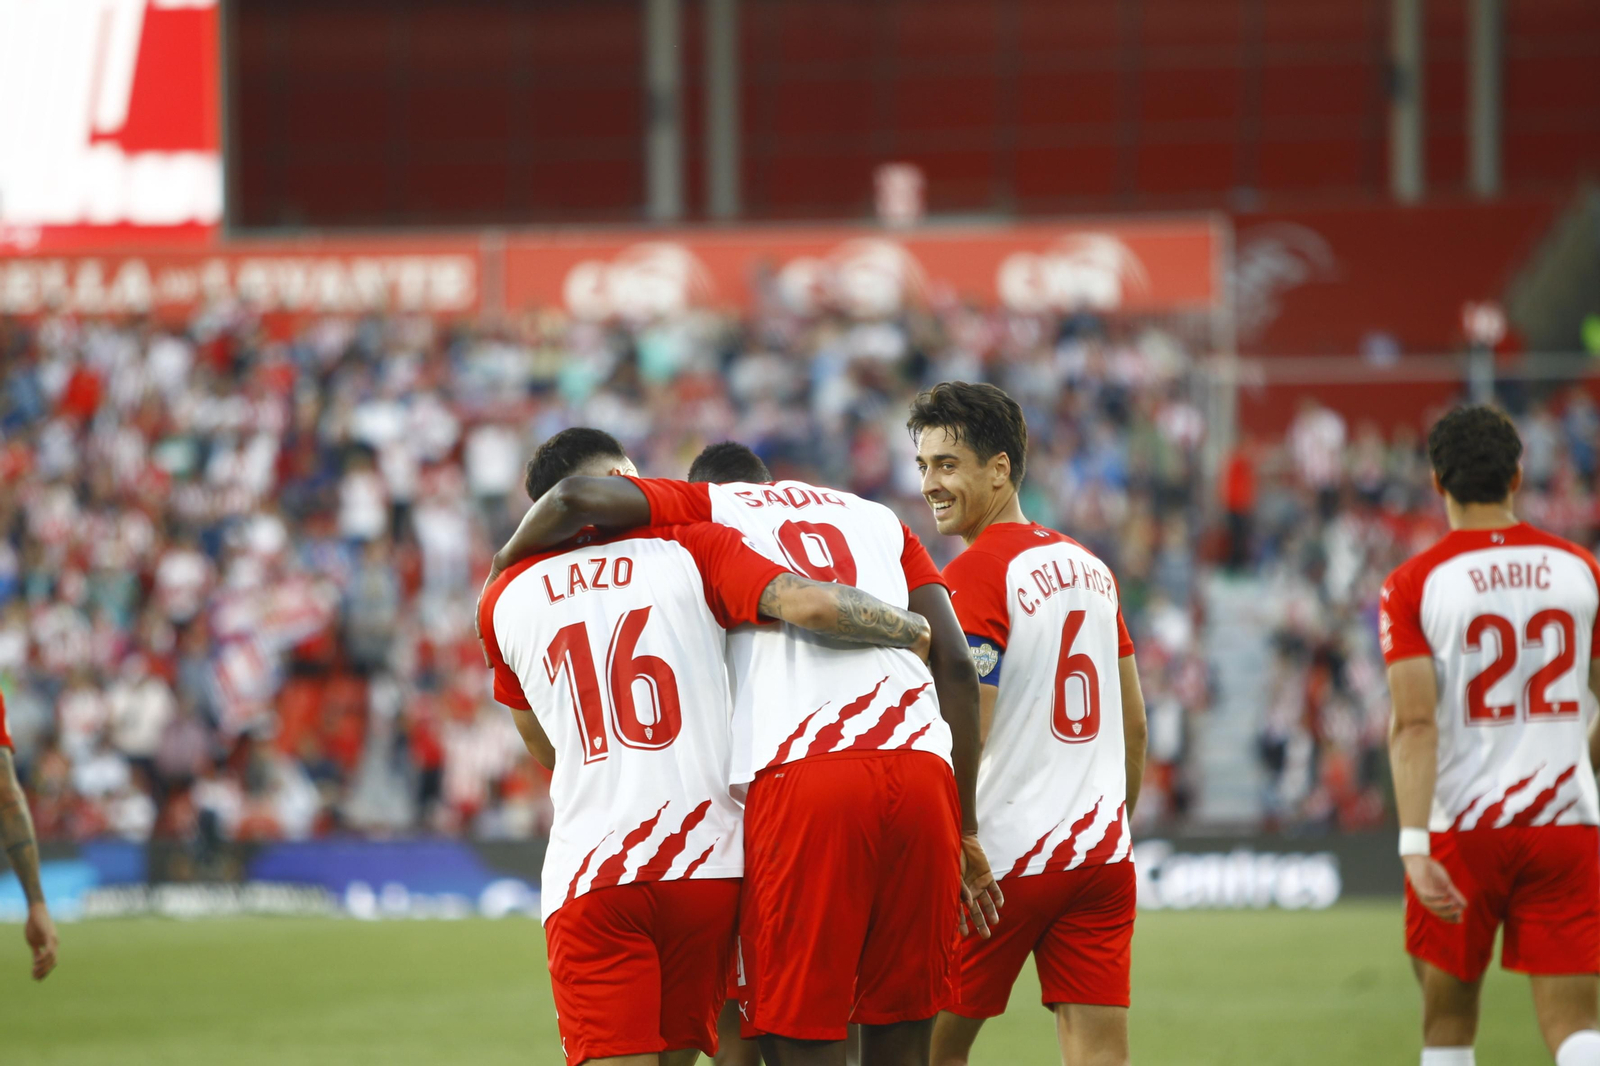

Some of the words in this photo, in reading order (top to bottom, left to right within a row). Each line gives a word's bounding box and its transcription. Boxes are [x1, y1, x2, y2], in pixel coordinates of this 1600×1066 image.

[734, 486, 850, 511] SADIQ
[541, 556, 634, 606] LAZO
[1467, 554, 1552, 594] BABIĆ
[543, 605, 682, 765] 16
[1050, 609, 1101, 745] 6
[1462, 608, 1579, 728] 22
